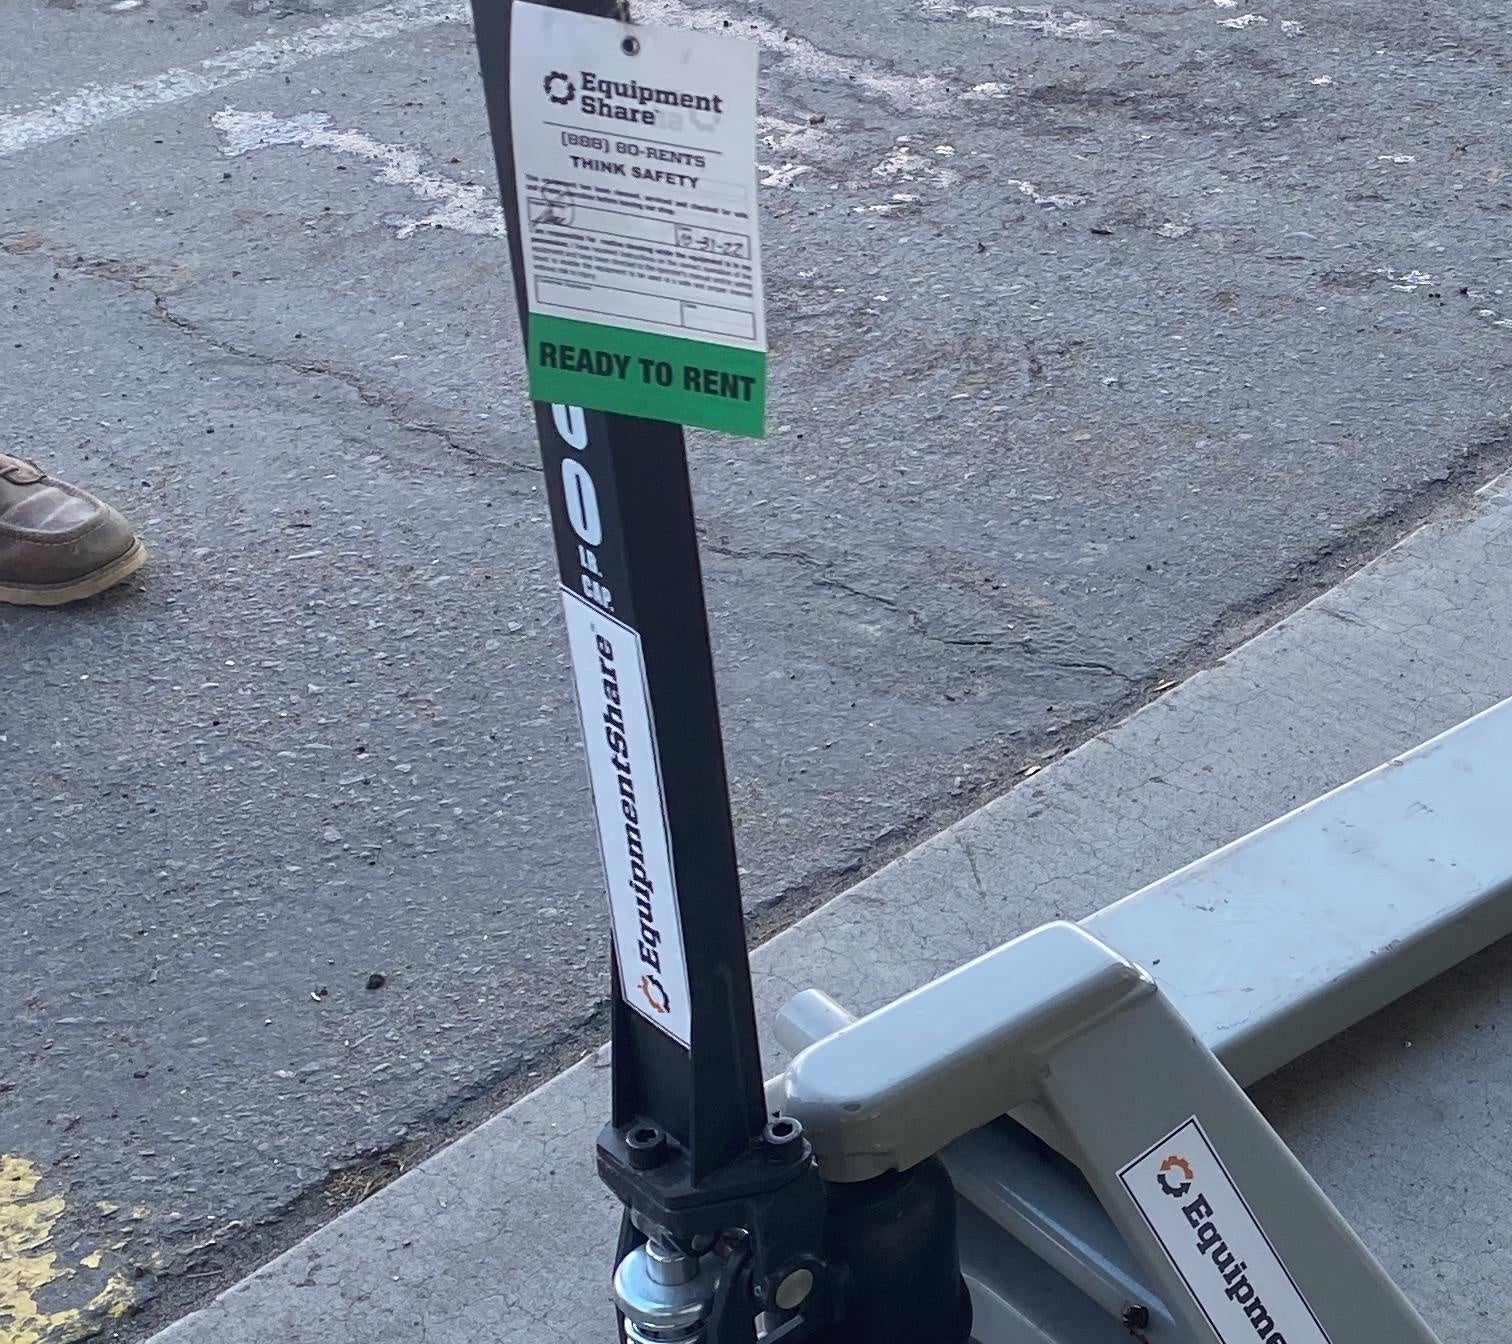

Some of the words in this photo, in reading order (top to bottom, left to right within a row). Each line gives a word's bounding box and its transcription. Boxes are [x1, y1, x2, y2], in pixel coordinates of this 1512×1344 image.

[579, 70, 723, 114] Equipment
[581, 95, 656, 126] Share
[569, 155, 626, 177] THINK
[631, 166, 698, 189] SAFETY
[540, 341, 632, 381] READY
[638, 358, 673, 388] TO
[683, 366, 756, 403] RENT
[595, 633, 661, 975] EquipmentShare
